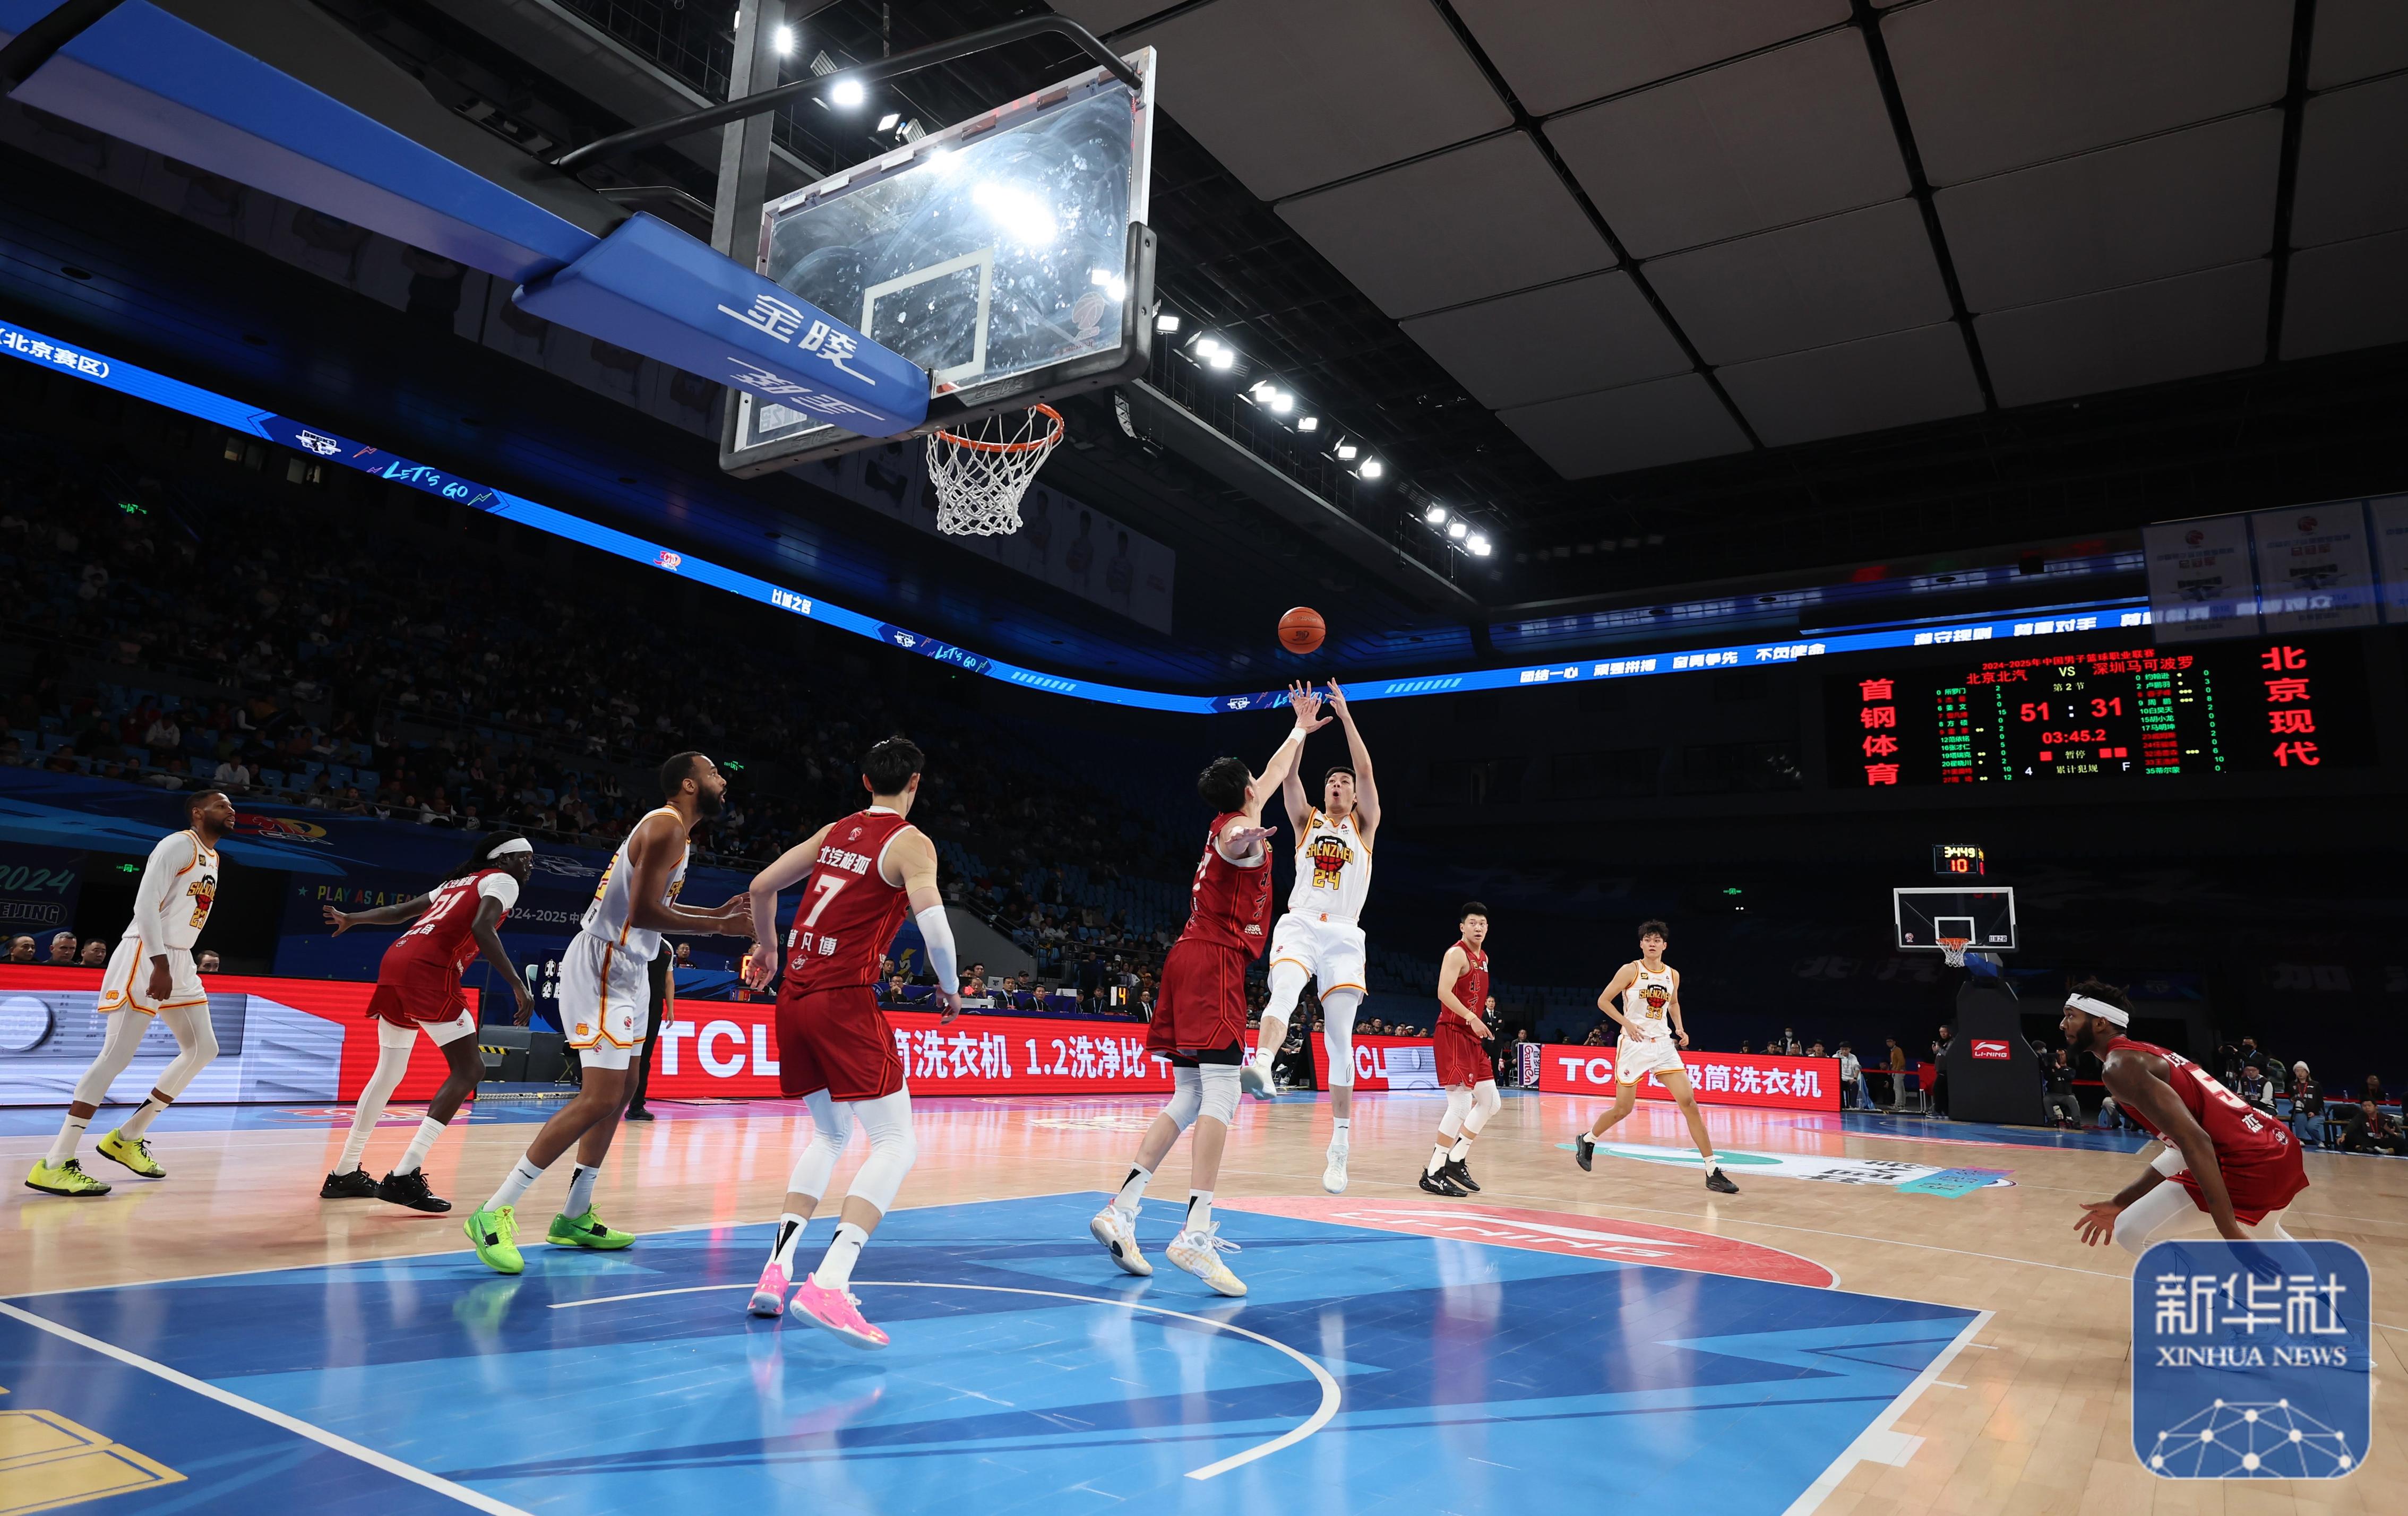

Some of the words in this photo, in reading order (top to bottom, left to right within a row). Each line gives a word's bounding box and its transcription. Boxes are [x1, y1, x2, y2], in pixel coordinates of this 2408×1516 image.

[0, 328, 110, 378] (北京赛区)
[717, 294, 876, 386] 金陵
[382, 461, 440, 486] LET'S
[442, 482, 468, 499] GO
[771, 588, 812, 615] 以城之名
[2013, 616, 2097, 637] 尊重对手
[935, 645, 962, 661] LET'S
[964, 656, 976, 668] GO
[1520, 667, 1578, 683] 团结一心
[1756, 643, 1826, 661] 不负使命
[1966, 669, 2028, 684] 北京北汽
[2058, 666, 2076, 677] VS
[2092, 656, 2194, 676] 深圳马可波罗
[2020, 702, 2050, 722] 51
[2091, 697, 2122, 718] 31
[2261, 646, 2321, 767] 北京现代
[1859, 678, 1900, 786] 首钢体育
[2042, 729, 2106, 744] 03:45.2
[2065, 750, 2086, 760] 暂停
[2025, 766, 2033, 776] 4
[2056, 763, 2099, 774] 累计犯规
[2122, 762, 2130, 771] F
[816, 846, 872, 875] 北汽极狐
[1305, 843, 1354, 865] SHENZHEN
[1951, 859, 1967, 872] 10
[1312, 868, 1340, 890] 24
[317, 885, 351, 902] PLAY
[355, 890, 372, 905] AS
[375, 892, 384, 906] A
[390, 894, 418, 905] TEA
[814, 874, 847, 927] 7
[787, 929, 838, 957] 曾凡博
[1119, 987, 1126, 1005] 4
[1639, 989, 1671, 1002] SHENZHE
[1646, 1005, 1663, 1020] 33
[658, 1020, 780, 1078] TCL
[1025, 1036, 1146, 1080] 1.2洗净比
[1352, 1045, 1389, 1080] CL
[1559, 1057, 1614, 1084] TC
